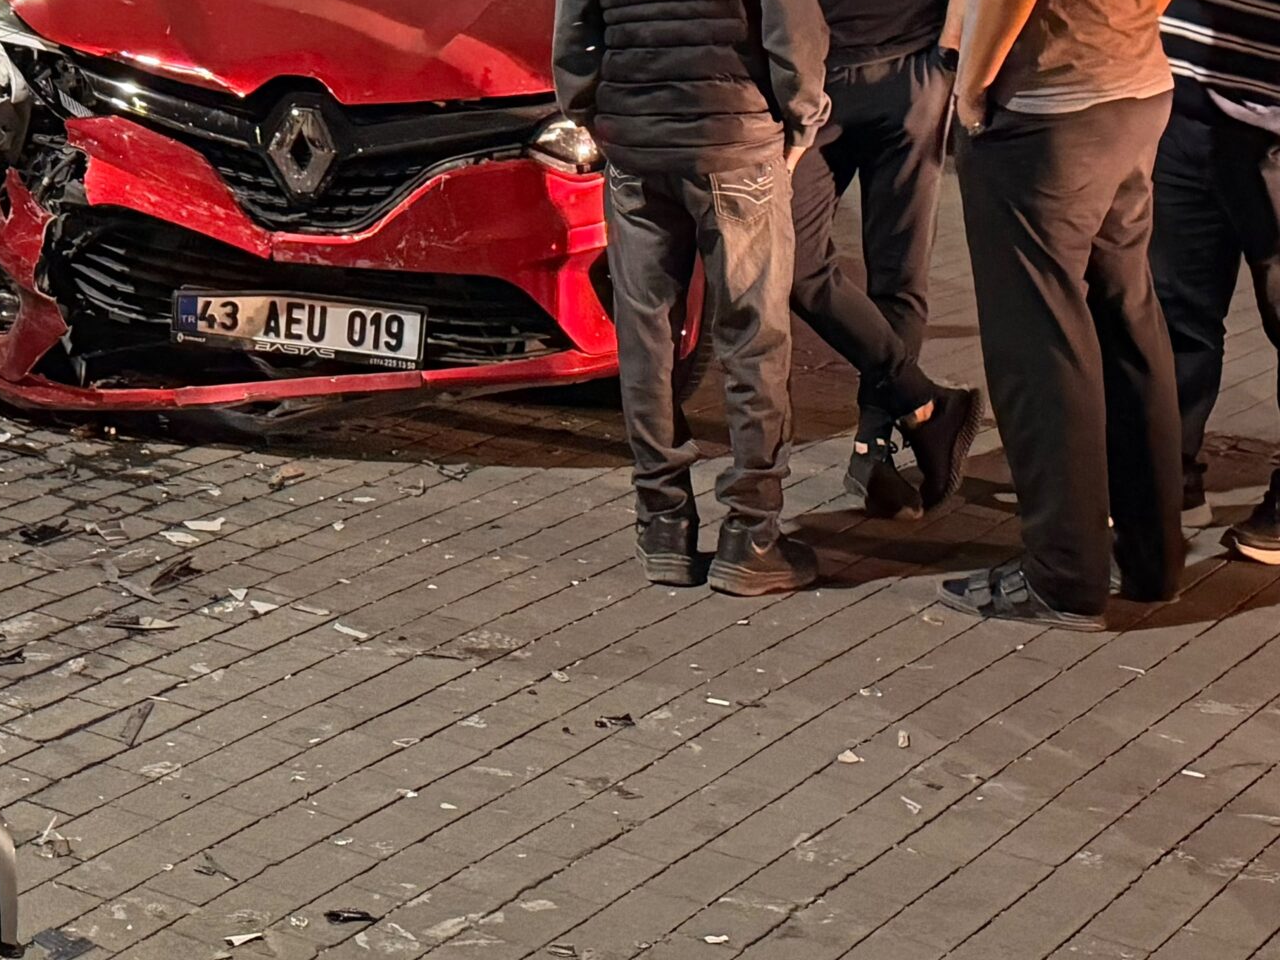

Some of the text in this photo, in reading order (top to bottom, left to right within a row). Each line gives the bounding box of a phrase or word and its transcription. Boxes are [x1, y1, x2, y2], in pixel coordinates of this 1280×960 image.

[181, 314, 196, 323] TR
[198, 299, 405, 353] 43 AEU 019
